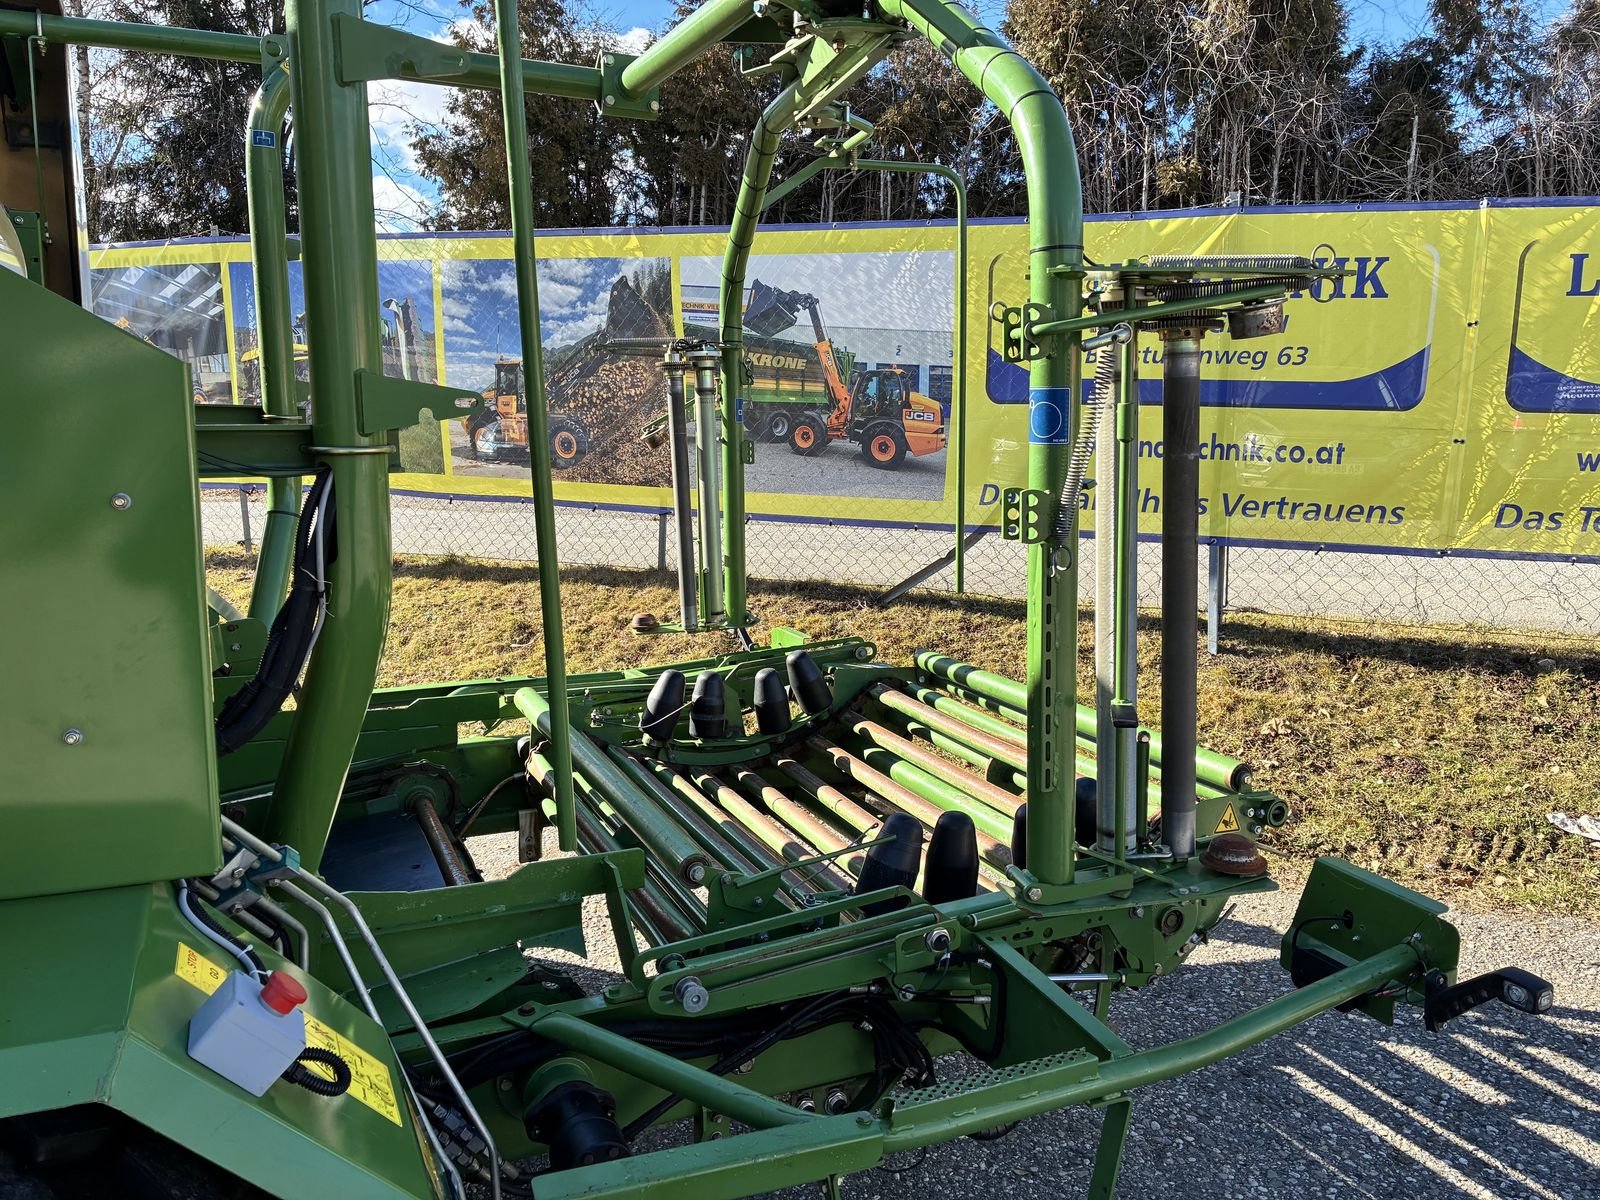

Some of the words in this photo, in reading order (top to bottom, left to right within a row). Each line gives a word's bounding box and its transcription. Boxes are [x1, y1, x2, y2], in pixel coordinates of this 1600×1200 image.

[747, 352, 808, 370] KRONE
[1277, 346, 1309, 366] 63
[905, 412, 935, 422] JCB
[1222, 492, 1406, 525] Vertrauens
[1494, 503, 1564, 531] Das
